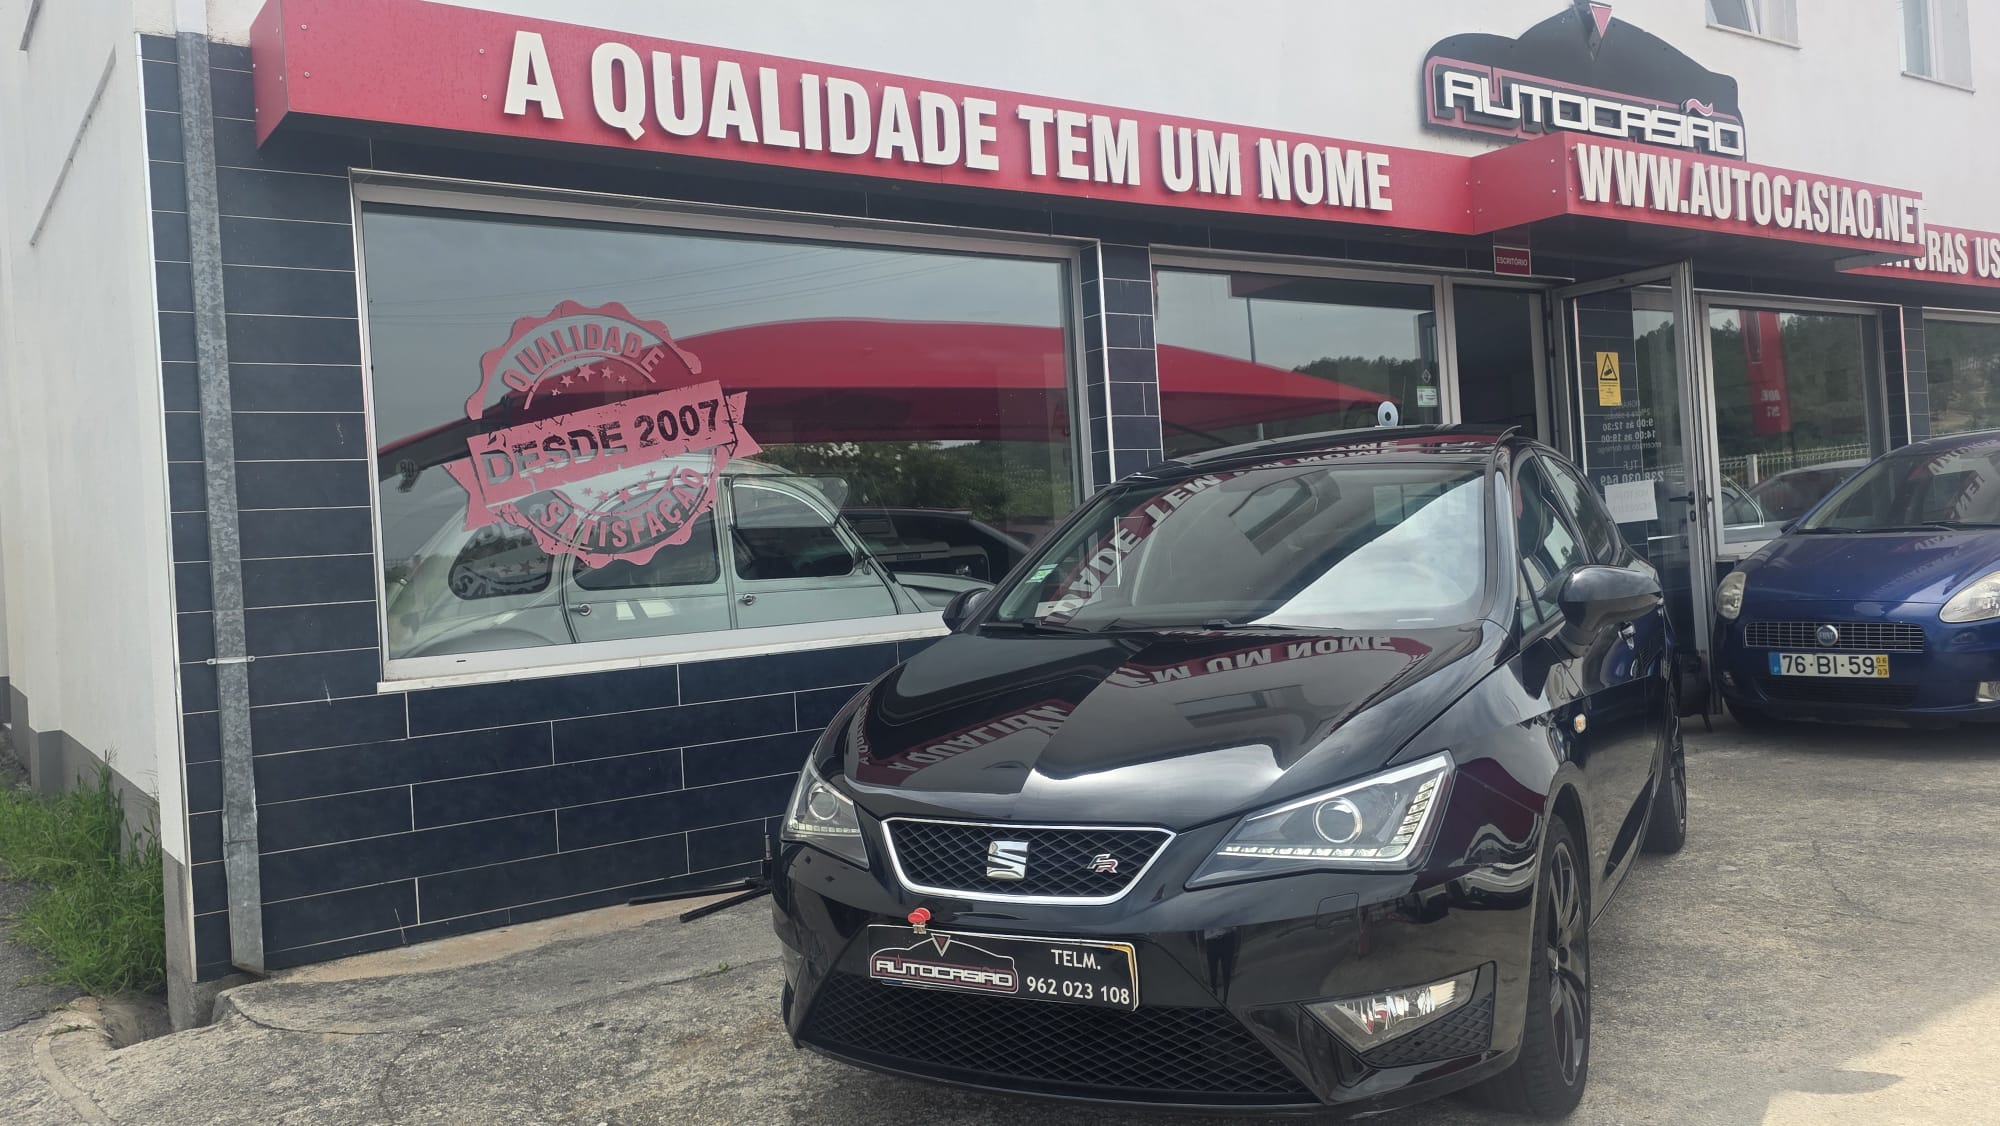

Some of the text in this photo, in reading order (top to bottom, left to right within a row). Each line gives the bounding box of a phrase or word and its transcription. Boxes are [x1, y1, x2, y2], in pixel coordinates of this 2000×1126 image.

[503, 30, 1393, 211] A QUALIDADE TEM UM NOME
[1443, 71, 1745, 157] AUTOCASIÃO
[1575, 143, 1926, 246] WWW.AUTOCASIAO.NET
[503, 323, 665, 392] QUALIDADE
[480, 399, 720, 486] DESDE 2007
[1087, 853, 1118, 873] FR
[1026, 976, 1130, 1005] 962 023 108
[1051, 948, 1102, 970] TELM.
